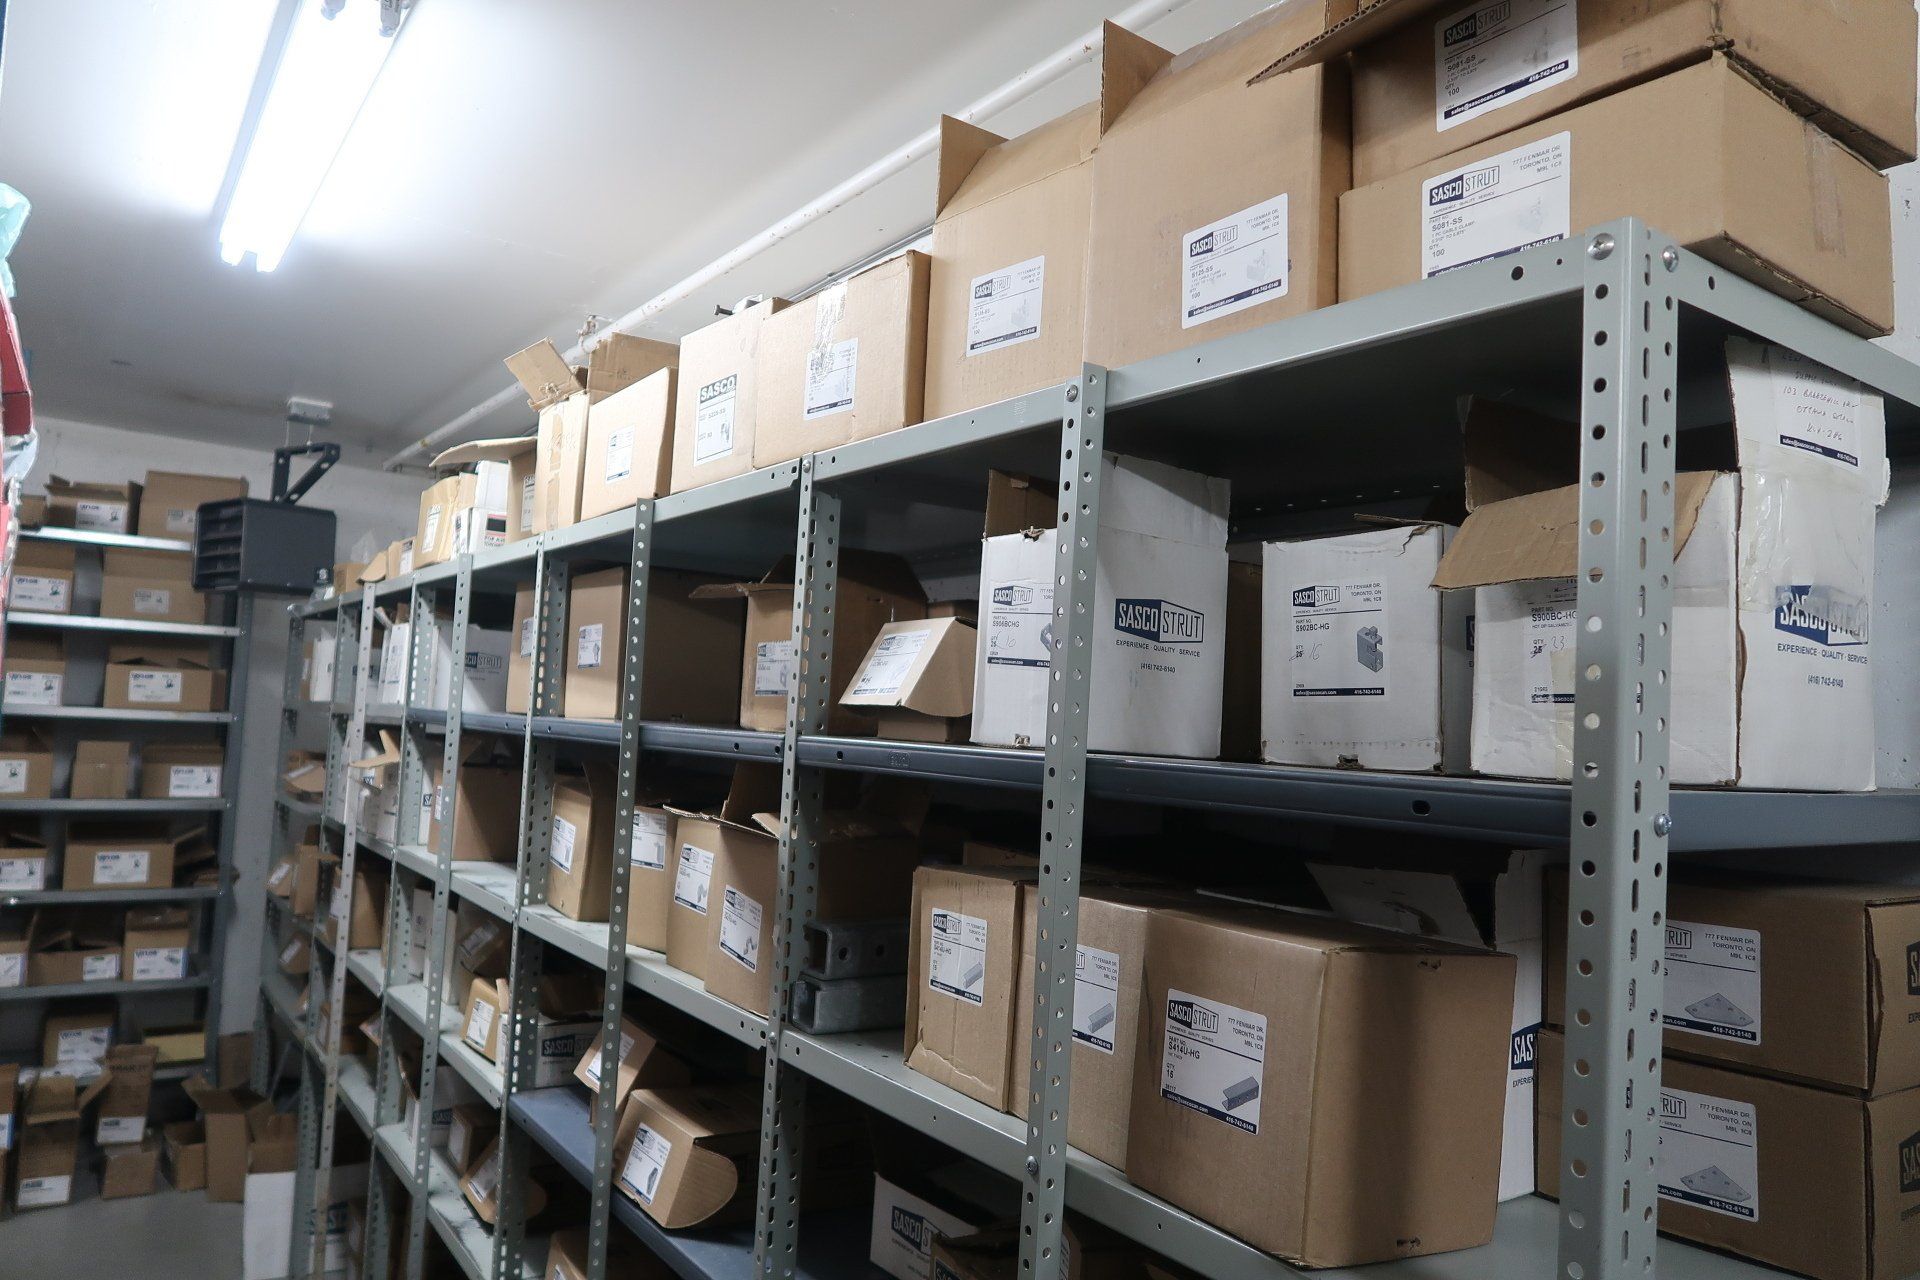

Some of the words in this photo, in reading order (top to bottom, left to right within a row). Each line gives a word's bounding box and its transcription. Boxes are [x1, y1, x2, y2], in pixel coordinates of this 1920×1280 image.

[1446, 21, 1476, 44] SASCO
[1477, 4, 1508, 33] STRUT
[1447, 54, 1476, 72] S081-SS
[1448, 86, 1460, 97] 100
[1431, 180, 1462, 203] SASCO
[1465, 168, 1497, 193] STRUT
[1431, 216, 1463, 231] S081-SS
[1191, 236, 1213, 256] SASCO
[1214, 227, 1236, 247] STRUT
[1432, 249, 1446, 257] 100
[975, 283, 992, 298] SASCO
[993, 276, 1009, 292] STRUT
[700, 376, 736, 402] SASCO
[1783, 386, 1797, 396] 103
[994, 589, 1013, 602] SASCO
[1013, 589, 1032, 602] STRUT
[1294, 590, 1315, 605] SASCO
[1316, 588, 1338, 603] STRUT
[1119, 603, 1159, 632] SASCO
[1162, 611, 1201, 639] STRUT
[1295, 623, 1330, 632] S902BC-HG
[1116, 639, 1150, 650] EXPERIENCE
[1153, 645, 1175, 654] QUALITY
[1179, 648, 1201, 658] SERVICE
[1777, 643, 1818, 656] EXPERIENCE
[1821, 649, 1844, 661] QUALITY
[1847, 653, 1868, 665] SERVICE
[1152, 664, 1176, 674] 742-6140
[1667, 930, 1689, 946] RUT
[1716, 934, 1744, 944] FENMAR
[1169, 1002, 1192, 1022] SASCO
[1193, 1009, 1217, 1030] STRUT
[1168, 1041, 1201, 1059] S414U-HG
[1513, 1033, 1534, 1065] SAS
[1166, 1069, 1174, 1078] 15
[1513, 1076, 1534, 1088] EXPERIEN
[1662, 1097, 1684, 1115] RUT
[1711, 1106, 1739, 1116] FENMAR
[1742, 1120, 1752, 1128] ON
[894, 1208, 921, 1243] SASCO
